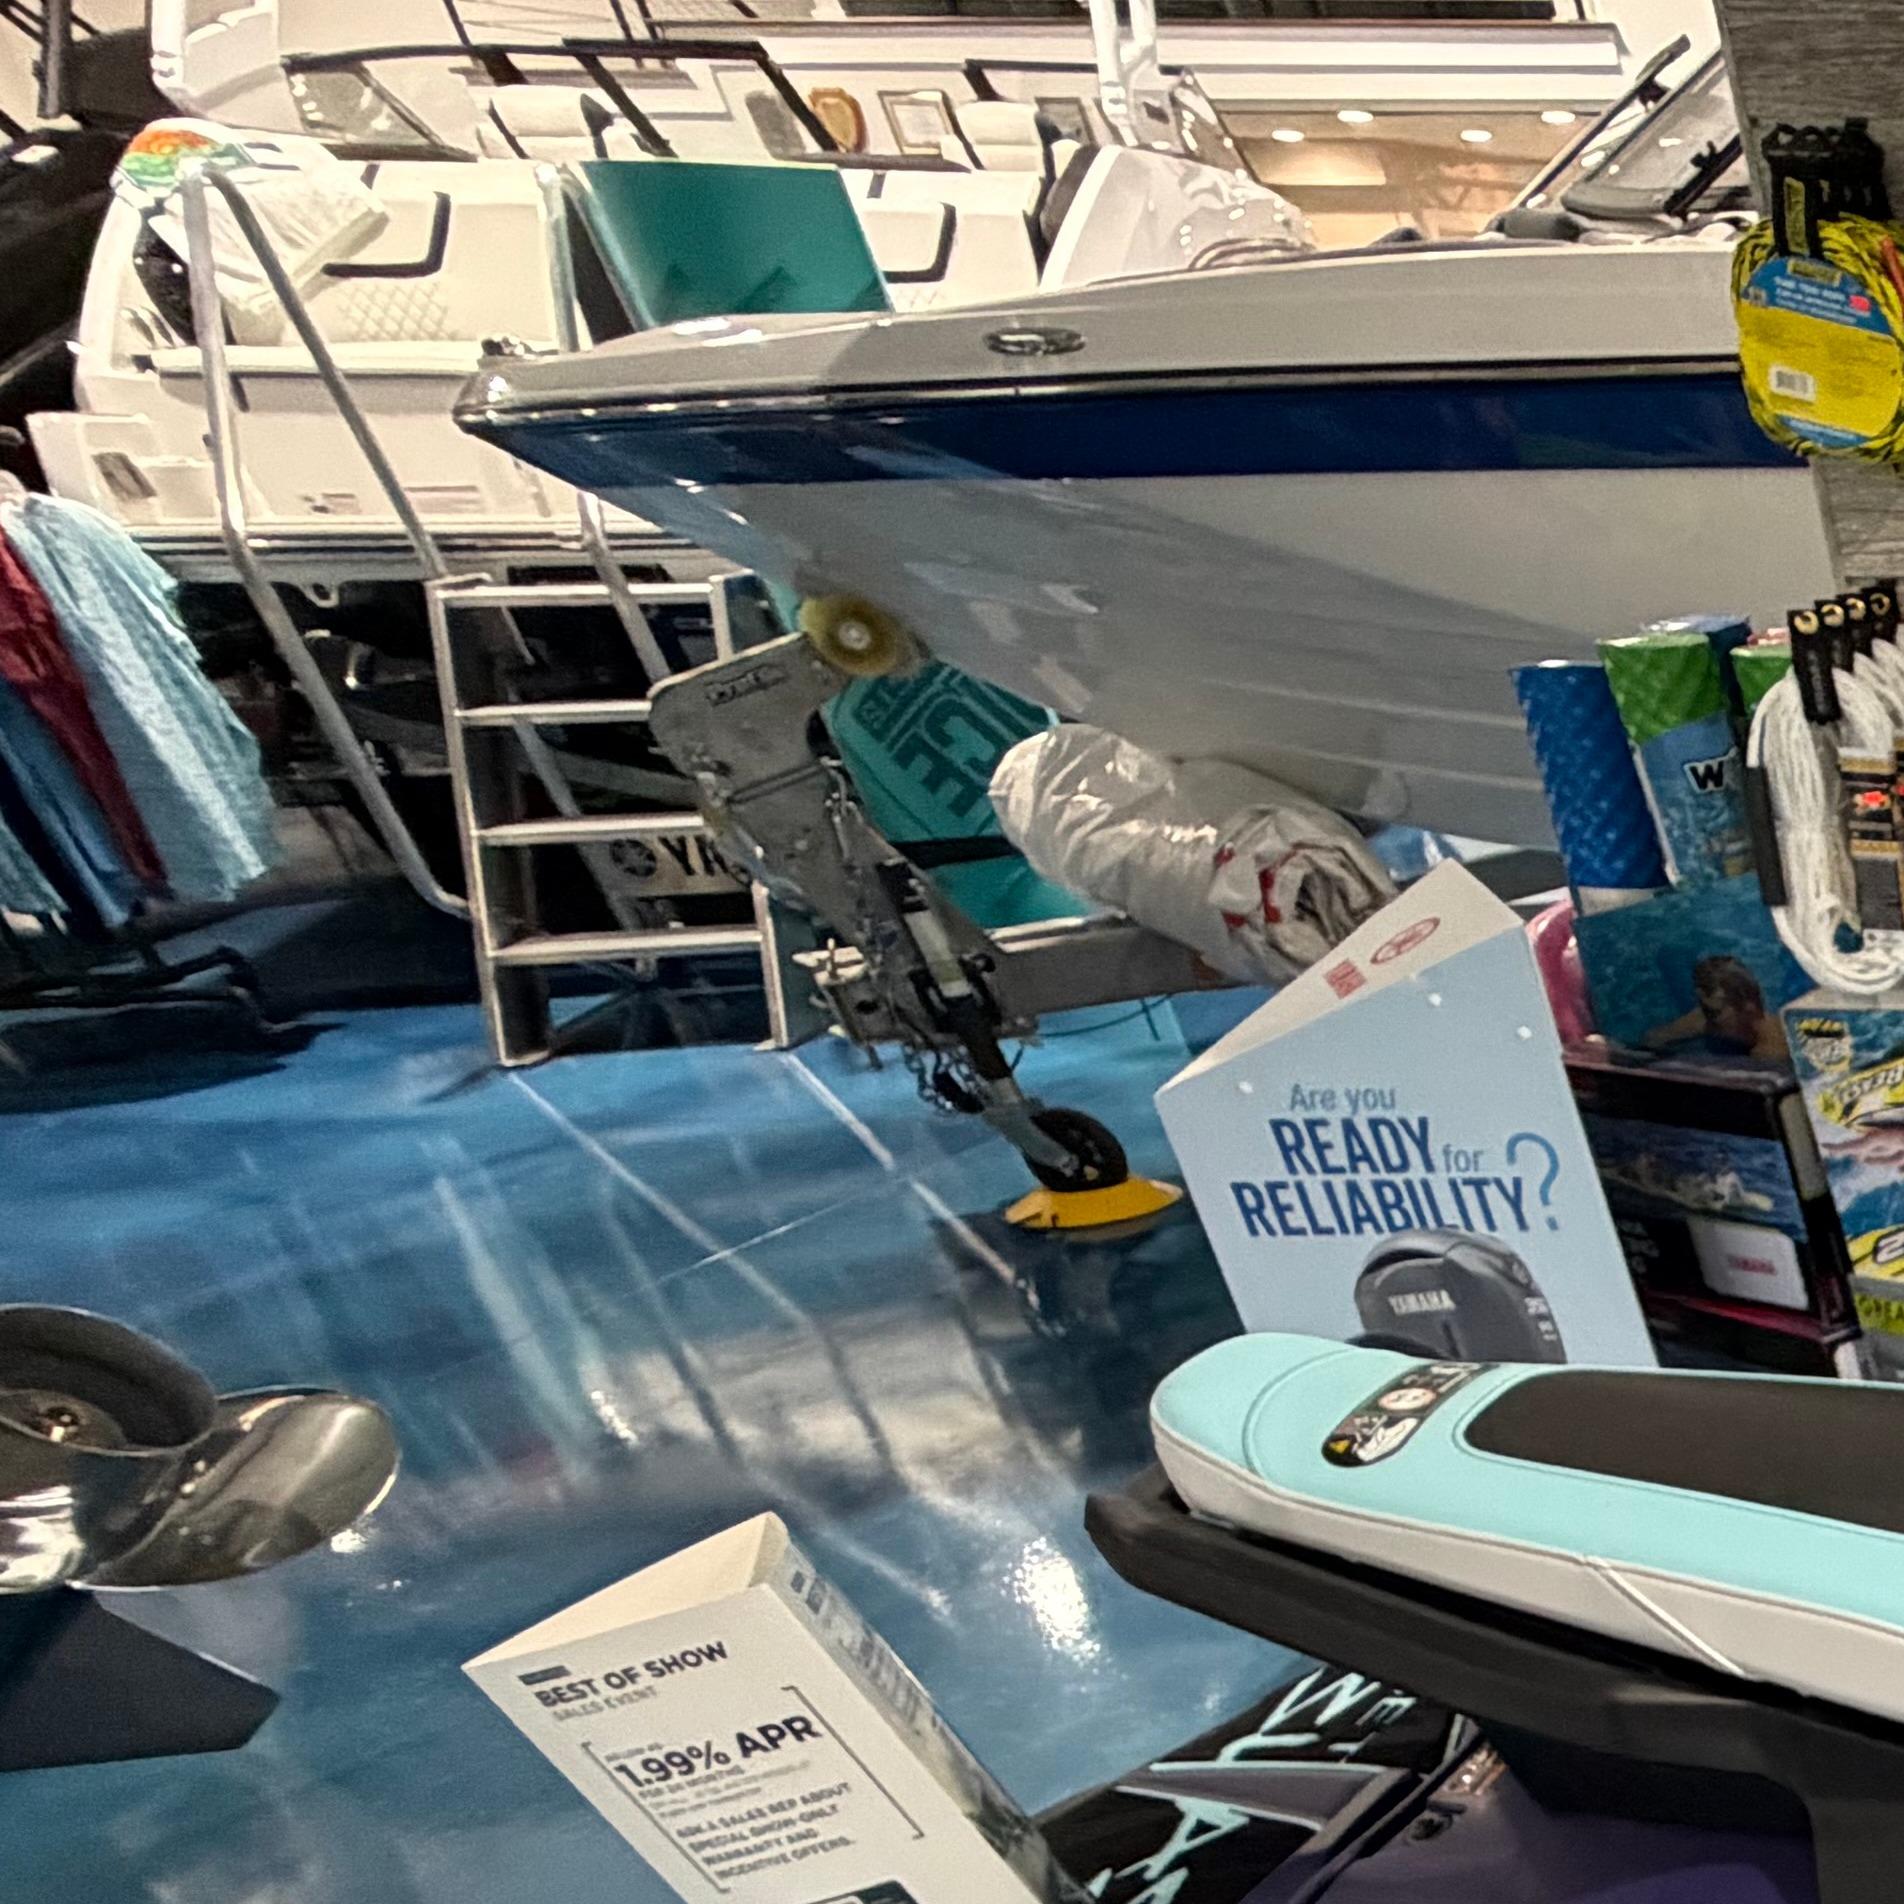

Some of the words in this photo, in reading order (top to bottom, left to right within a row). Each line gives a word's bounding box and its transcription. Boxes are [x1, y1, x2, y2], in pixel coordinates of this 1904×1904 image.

[1289, 1083, 1337, 1112] Are
[1343, 1087, 1398, 1116] you
[1268, 1115, 1436, 1176] READY
[1441, 1143, 1485, 1174] for
[534, 1678, 600, 1708] BEST
[603, 1666, 641, 1690] OF
[643, 1641, 728, 1678] SHOW
[552, 1700, 604, 1722] SALES
[603, 1685, 657, 1709] EVENT
[614, 1740, 731, 1788] 1.99%
[735, 1716, 822, 1759] APR
[718, 1807, 768, 1828] SALES
[799, 1782, 851, 1806] ABOUT
[687, 1832, 750, 1854] SPECIAL
[701, 1837, 783, 1867] WARRANTY
[785, 1828, 819, 1845] AND
[714, 1853, 792, 1880] INCENTIVE
